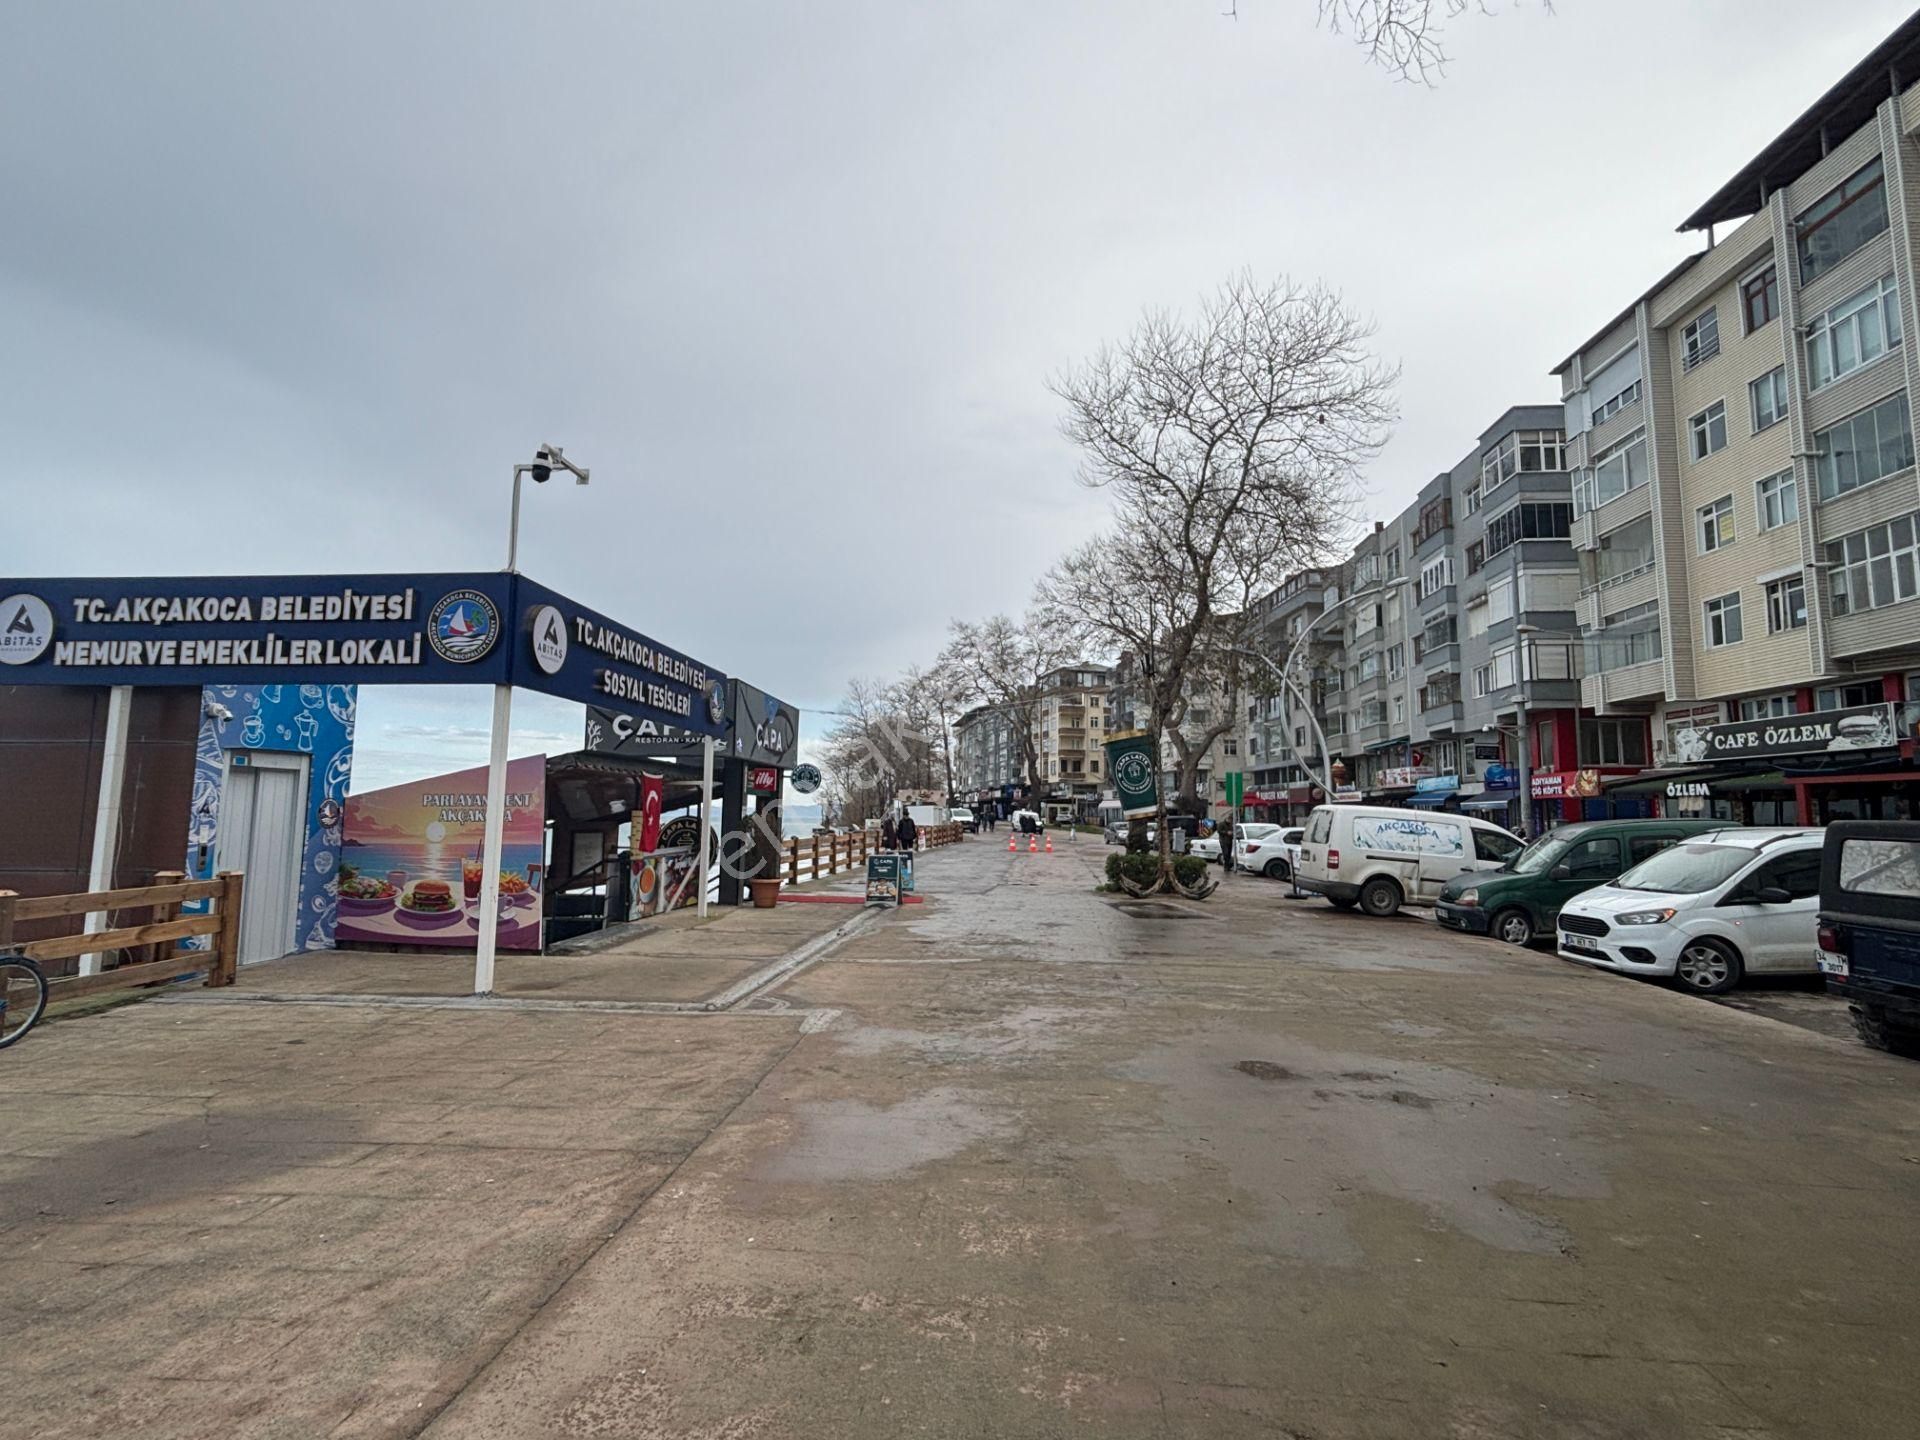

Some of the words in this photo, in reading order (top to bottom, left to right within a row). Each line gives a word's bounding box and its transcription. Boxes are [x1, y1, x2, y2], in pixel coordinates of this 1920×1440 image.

[260, 588, 414, 621] BELEDİYESİ
[53, 640, 143, 666] MEMUR
[145, 640, 176, 665] VE
[178, 633, 323, 666] EMEKLİLER
[325, 632, 422, 665] LOKALİ
[658, 652, 707, 691] BELEDİYESİ
[604, 669, 645, 703] SOSYAL
[647, 682, 691, 717] TESİSLERİ
[635, 736, 681, 744] RESTORAN
[756, 723, 783, 751] ÇAPA
[1714, 731, 1759, 750] CAFE
[1764, 723, 1833, 745] ÖZLEM
[755, 771, 774, 788] illy
[1666, 782, 1711, 797] ÖZLEM
[503, 793, 532, 808] ENT
[438, 809, 513, 825] AKÇAKA
